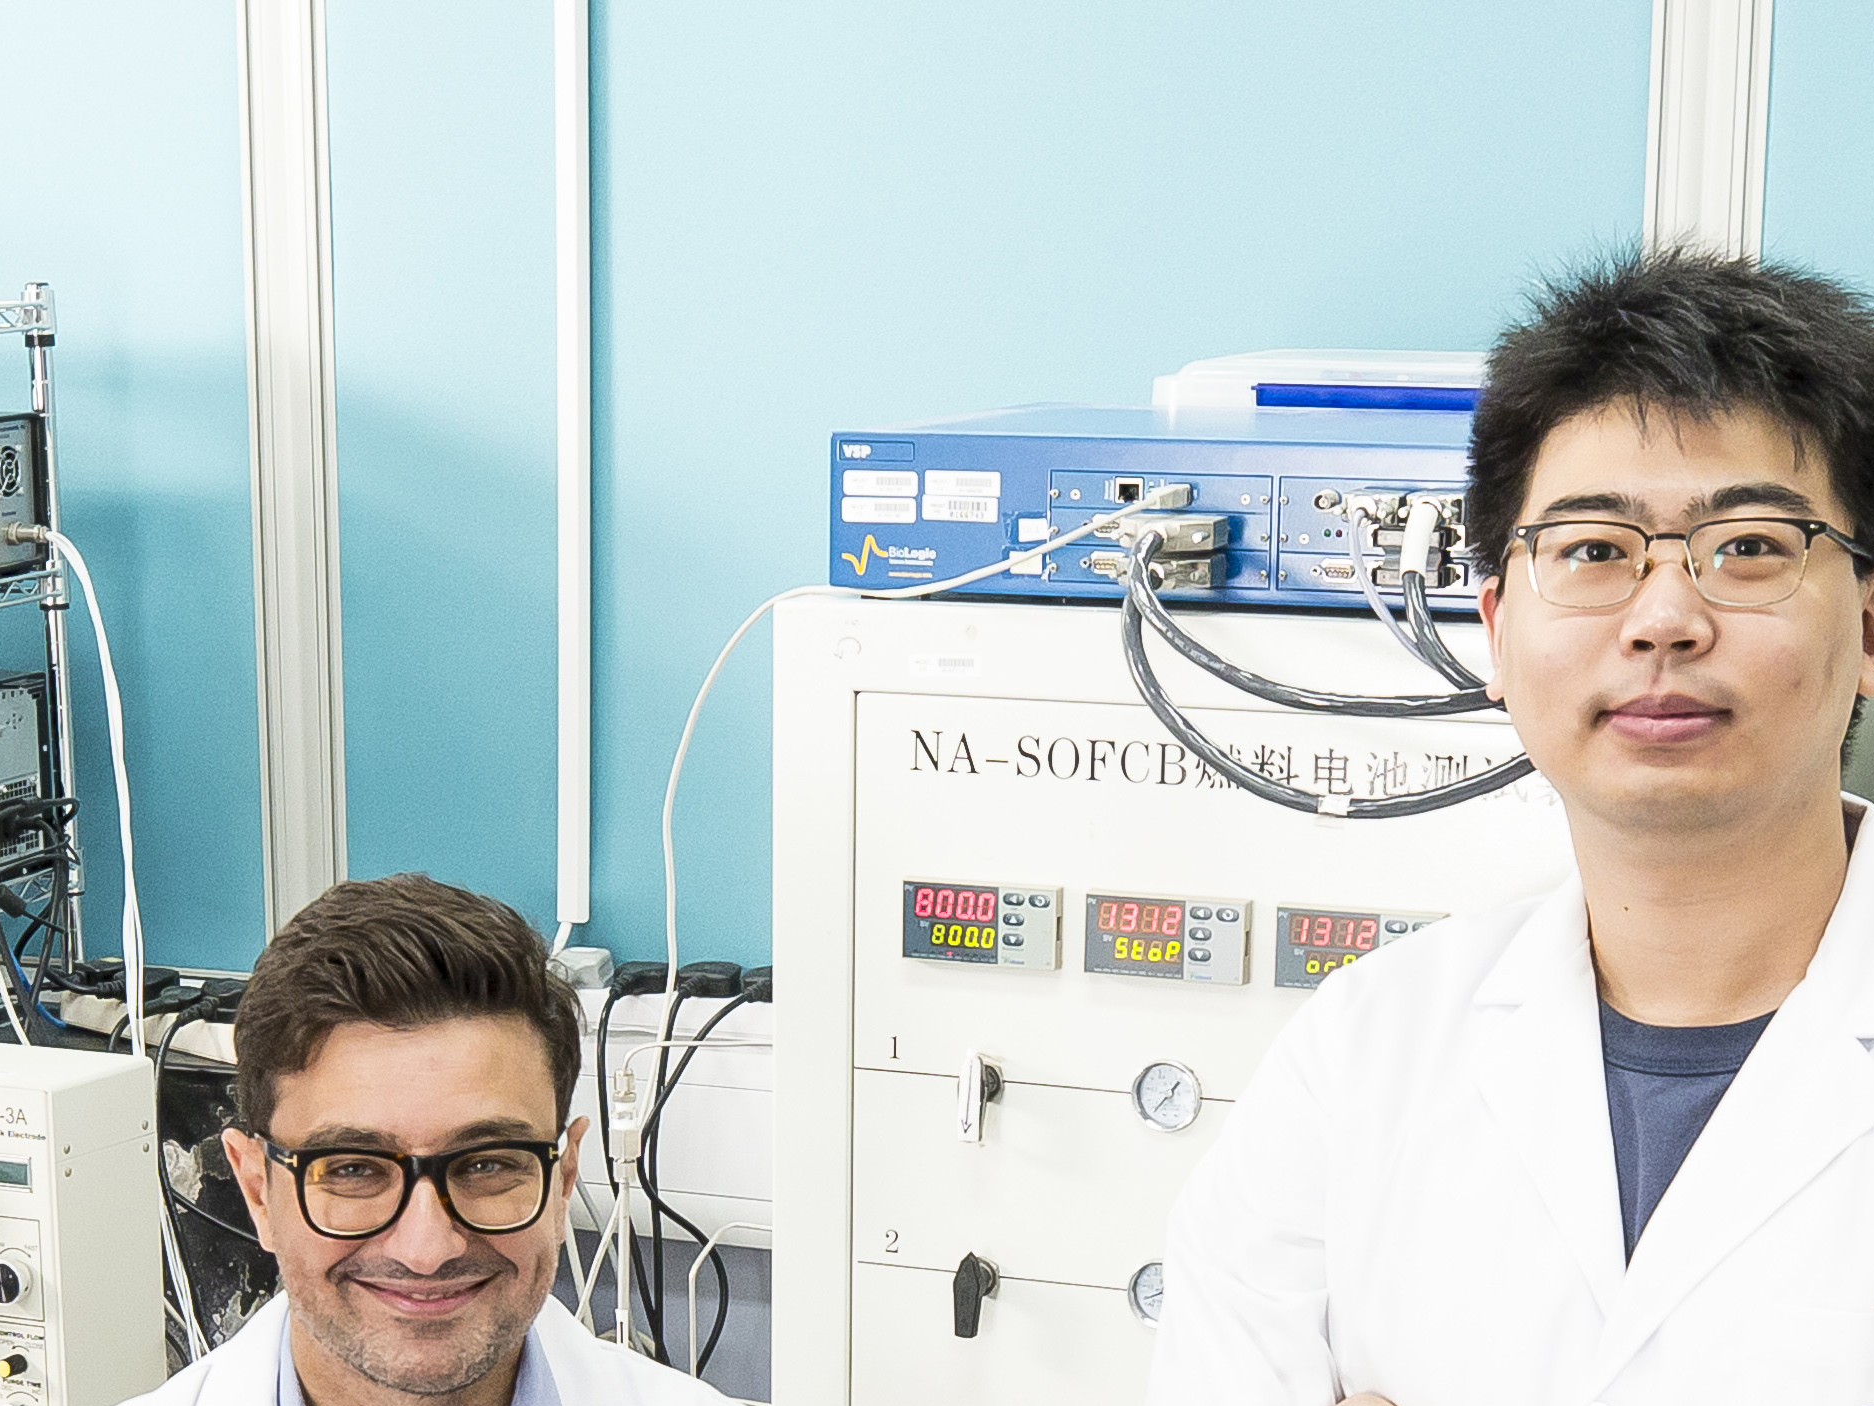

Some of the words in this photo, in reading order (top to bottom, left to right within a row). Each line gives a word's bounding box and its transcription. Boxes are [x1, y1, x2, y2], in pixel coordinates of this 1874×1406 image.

[842, 444, 872, 459] VSP
[888, 546, 937, 560] BioLogic
[915, 888, 996, 922] 800.0
[1107, 903, 1183, 936] 1312
[931, 924, 995, 949] 800.0
[1299, 917, 1377, 950] 1312
[889, 1035, 901, 1060] 1
[8, 1130, 46, 1140] Electrode
[885, 1229, 899, 1254] 2
